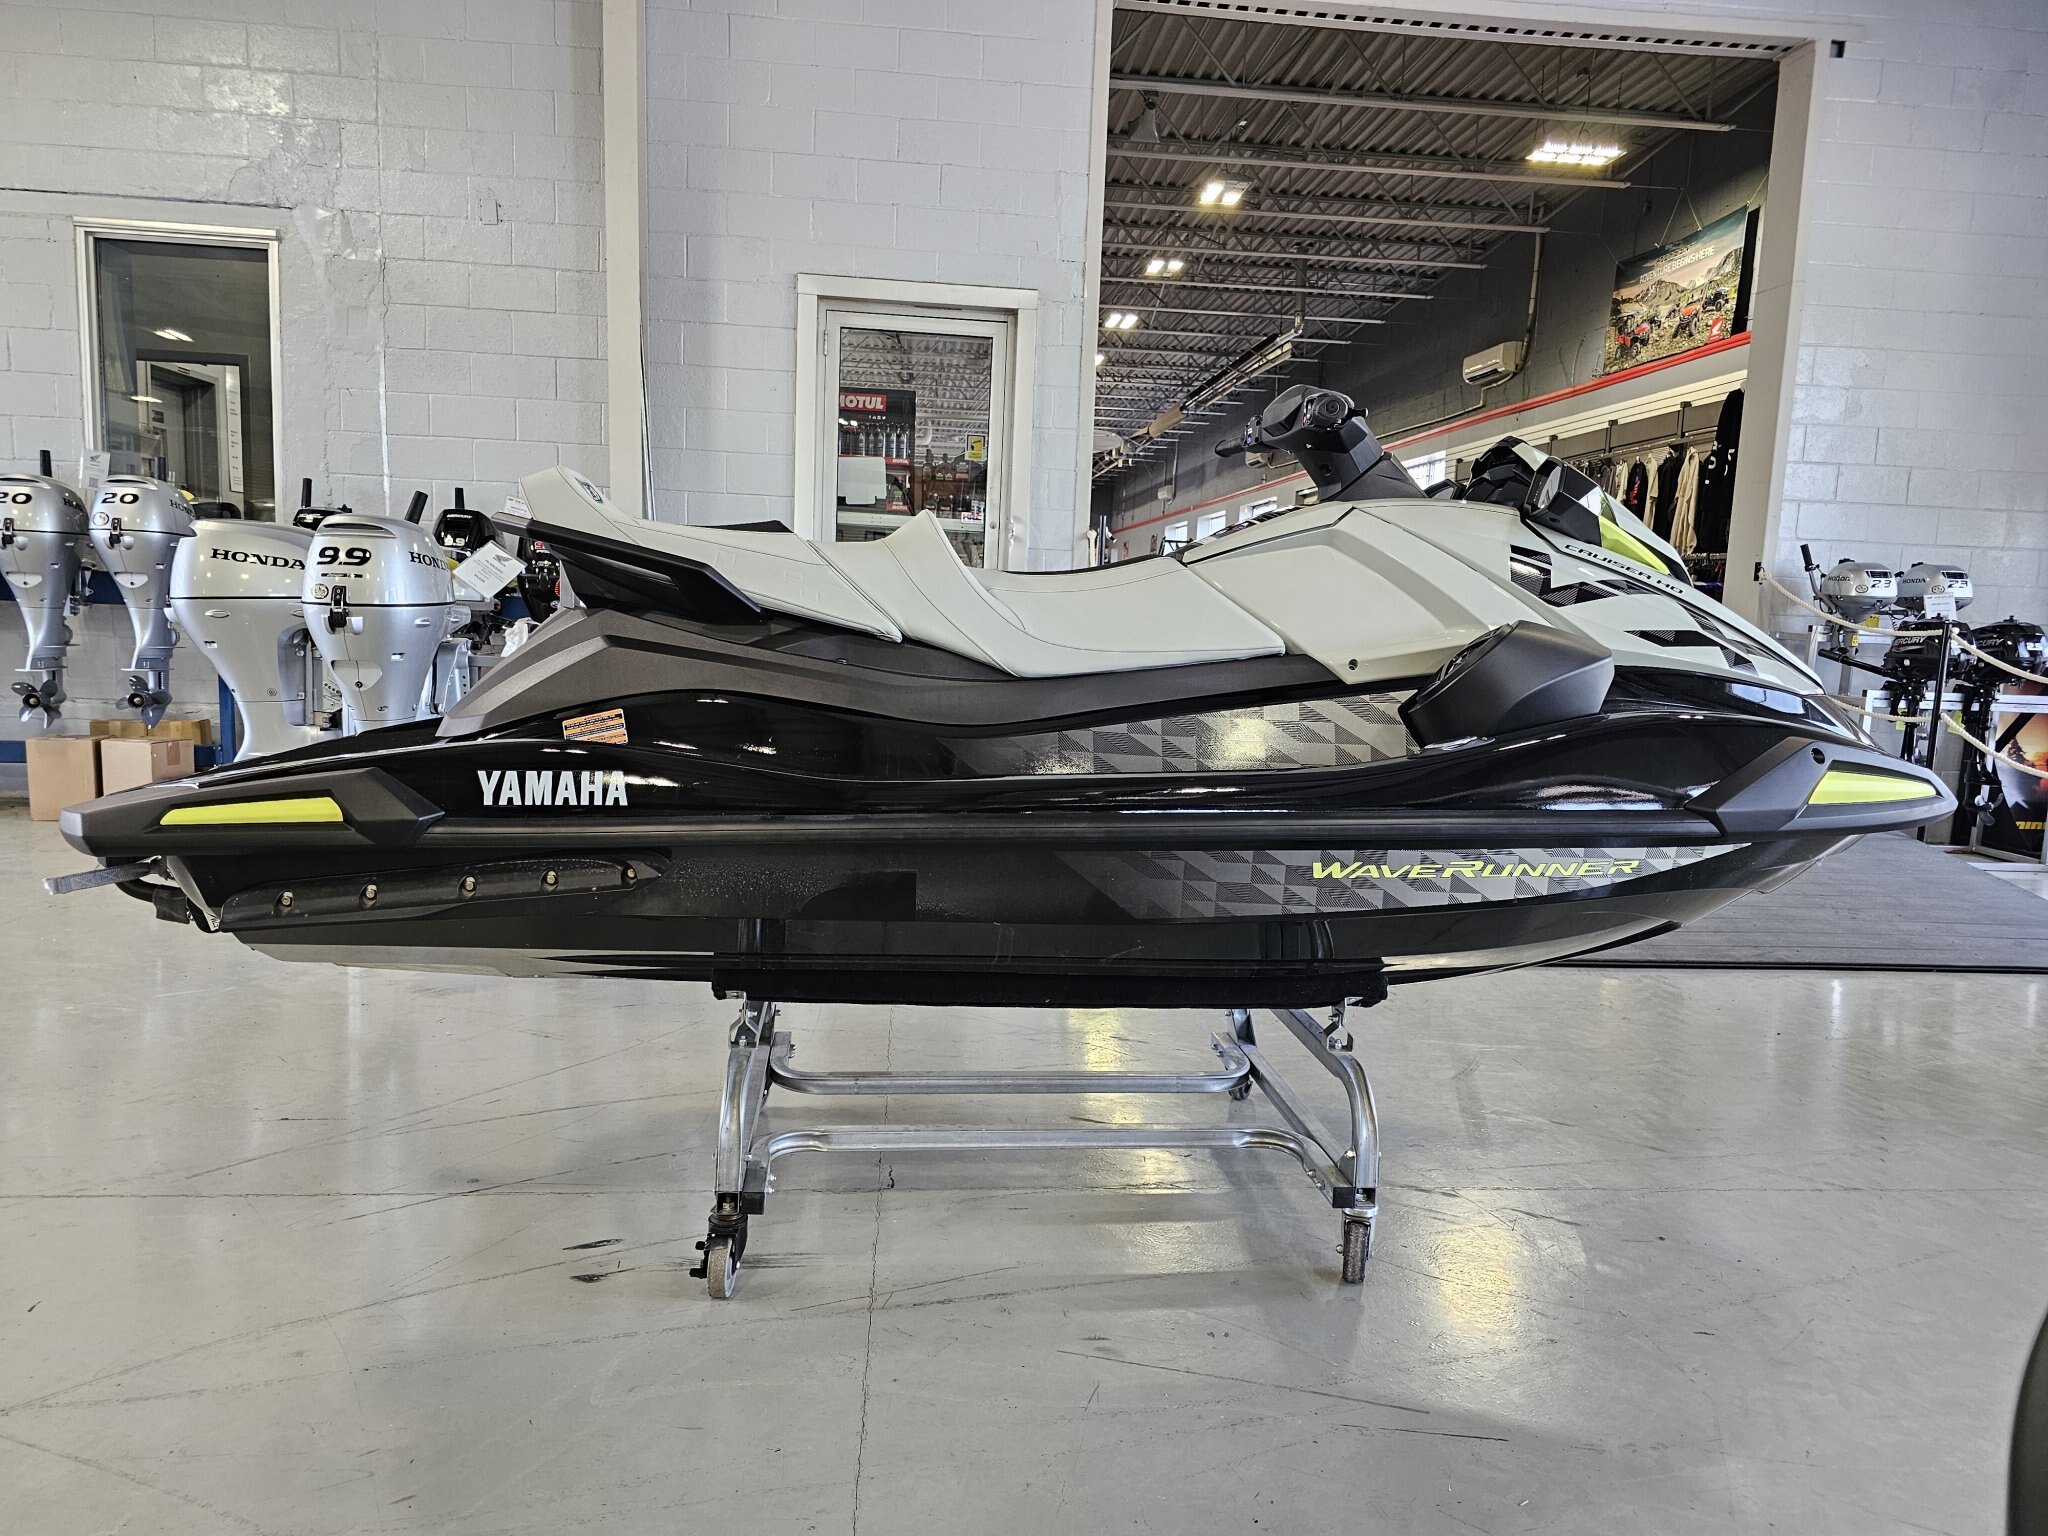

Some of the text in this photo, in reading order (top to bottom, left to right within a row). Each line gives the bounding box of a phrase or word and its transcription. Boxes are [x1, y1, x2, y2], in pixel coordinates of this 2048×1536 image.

[101, 492, 140, 505] 20
[210, 548, 306, 570] HONDA
[316, 546, 372, 566] 9.9
[408, 551, 450, 573] HOND
[1564, 544, 1684, 594] CRUISER HO
[477, 770, 629, 806] YAMAHA
